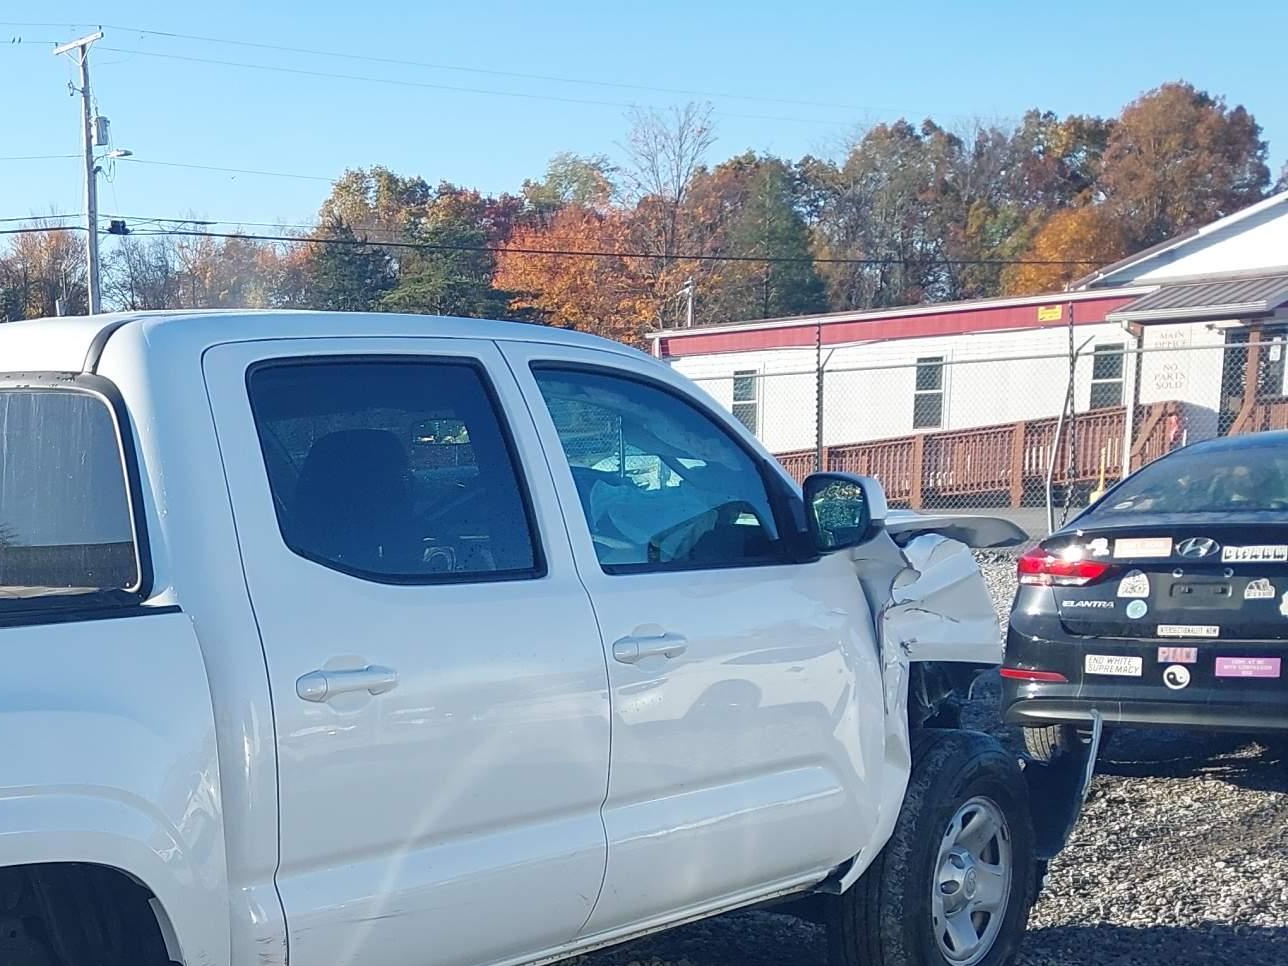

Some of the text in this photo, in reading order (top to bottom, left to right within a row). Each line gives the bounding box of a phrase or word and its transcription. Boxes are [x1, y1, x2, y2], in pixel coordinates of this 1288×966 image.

[1160, 329, 1185, 339] MAIN
[1163, 362, 1179, 371] NO
[1154, 372, 1186, 382] PARTS
[1155, 381, 1183, 390] SOLD
[1061, 600, 1115, 609] ELANTRA
[1087, 656, 1134, 666] END WHITE
[1087, 664, 1141, 674] SUPREMACY
